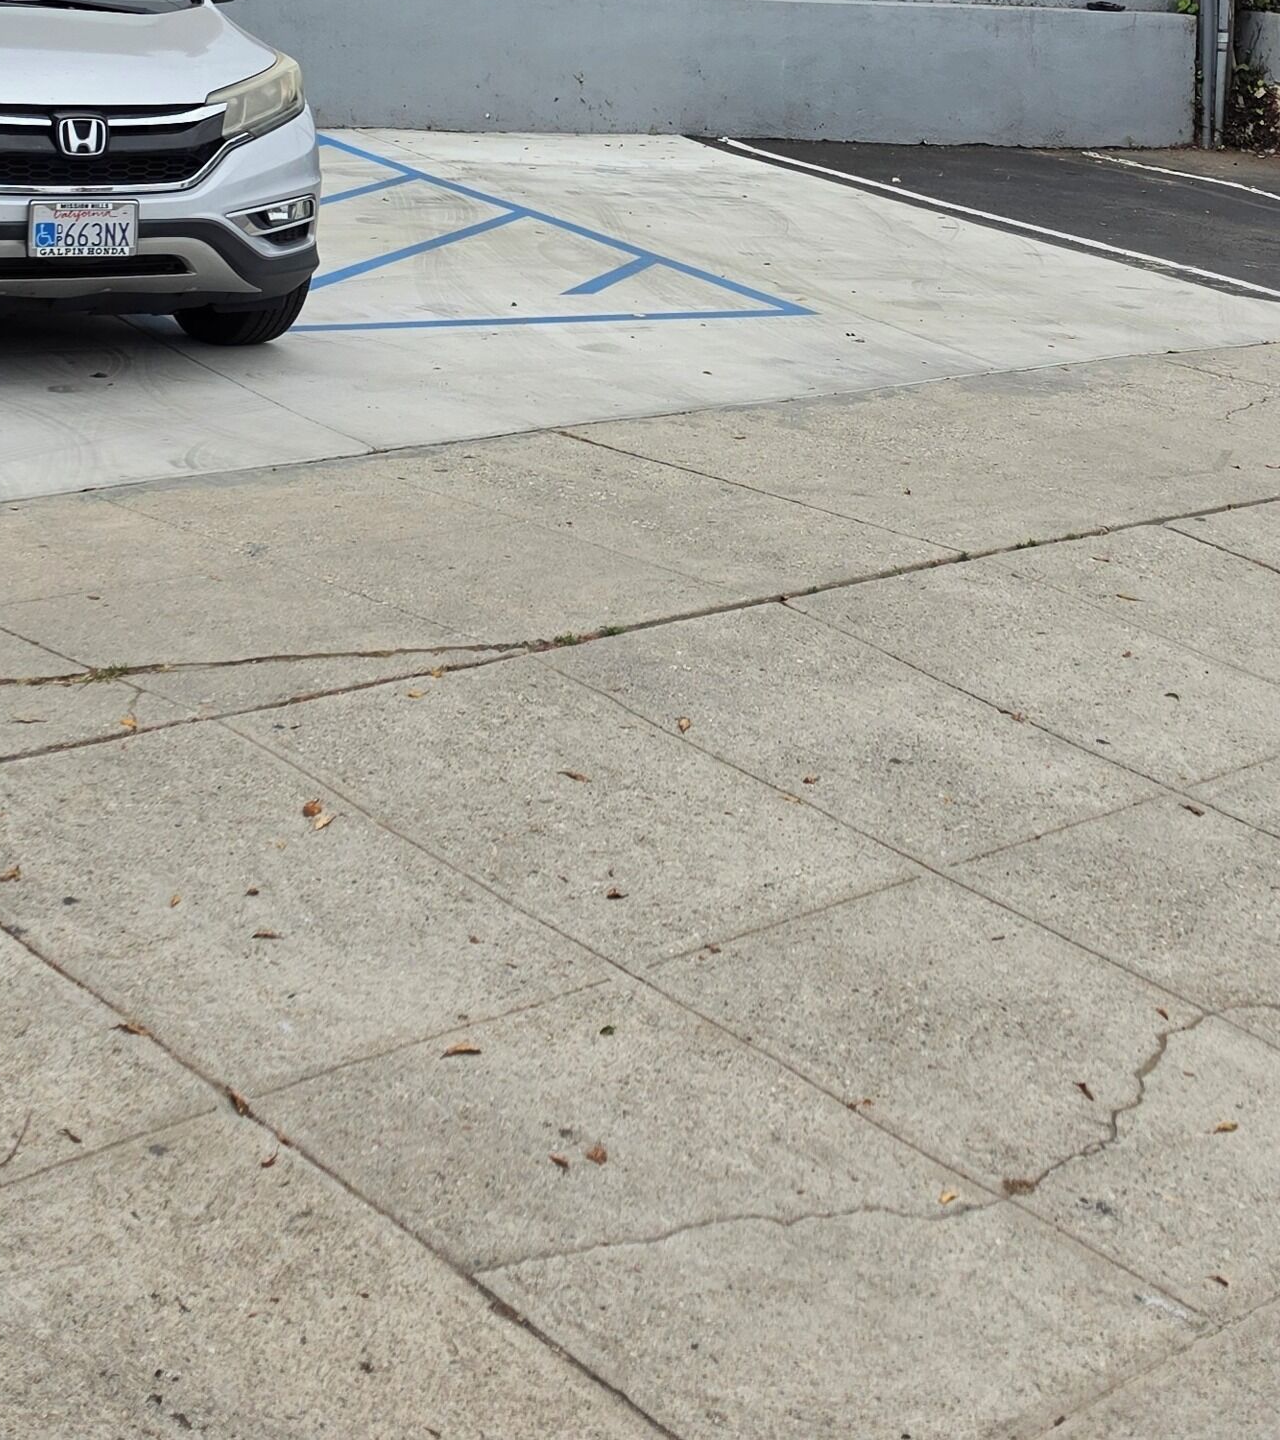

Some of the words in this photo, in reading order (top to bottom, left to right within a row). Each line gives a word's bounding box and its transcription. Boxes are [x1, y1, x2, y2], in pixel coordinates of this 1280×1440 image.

[53, 209, 119, 222] California
[64, 222, 130, 247] 663NX
[40, 247, 84, 256] GALPIN
[87, 247, 126, 256] HONDA
